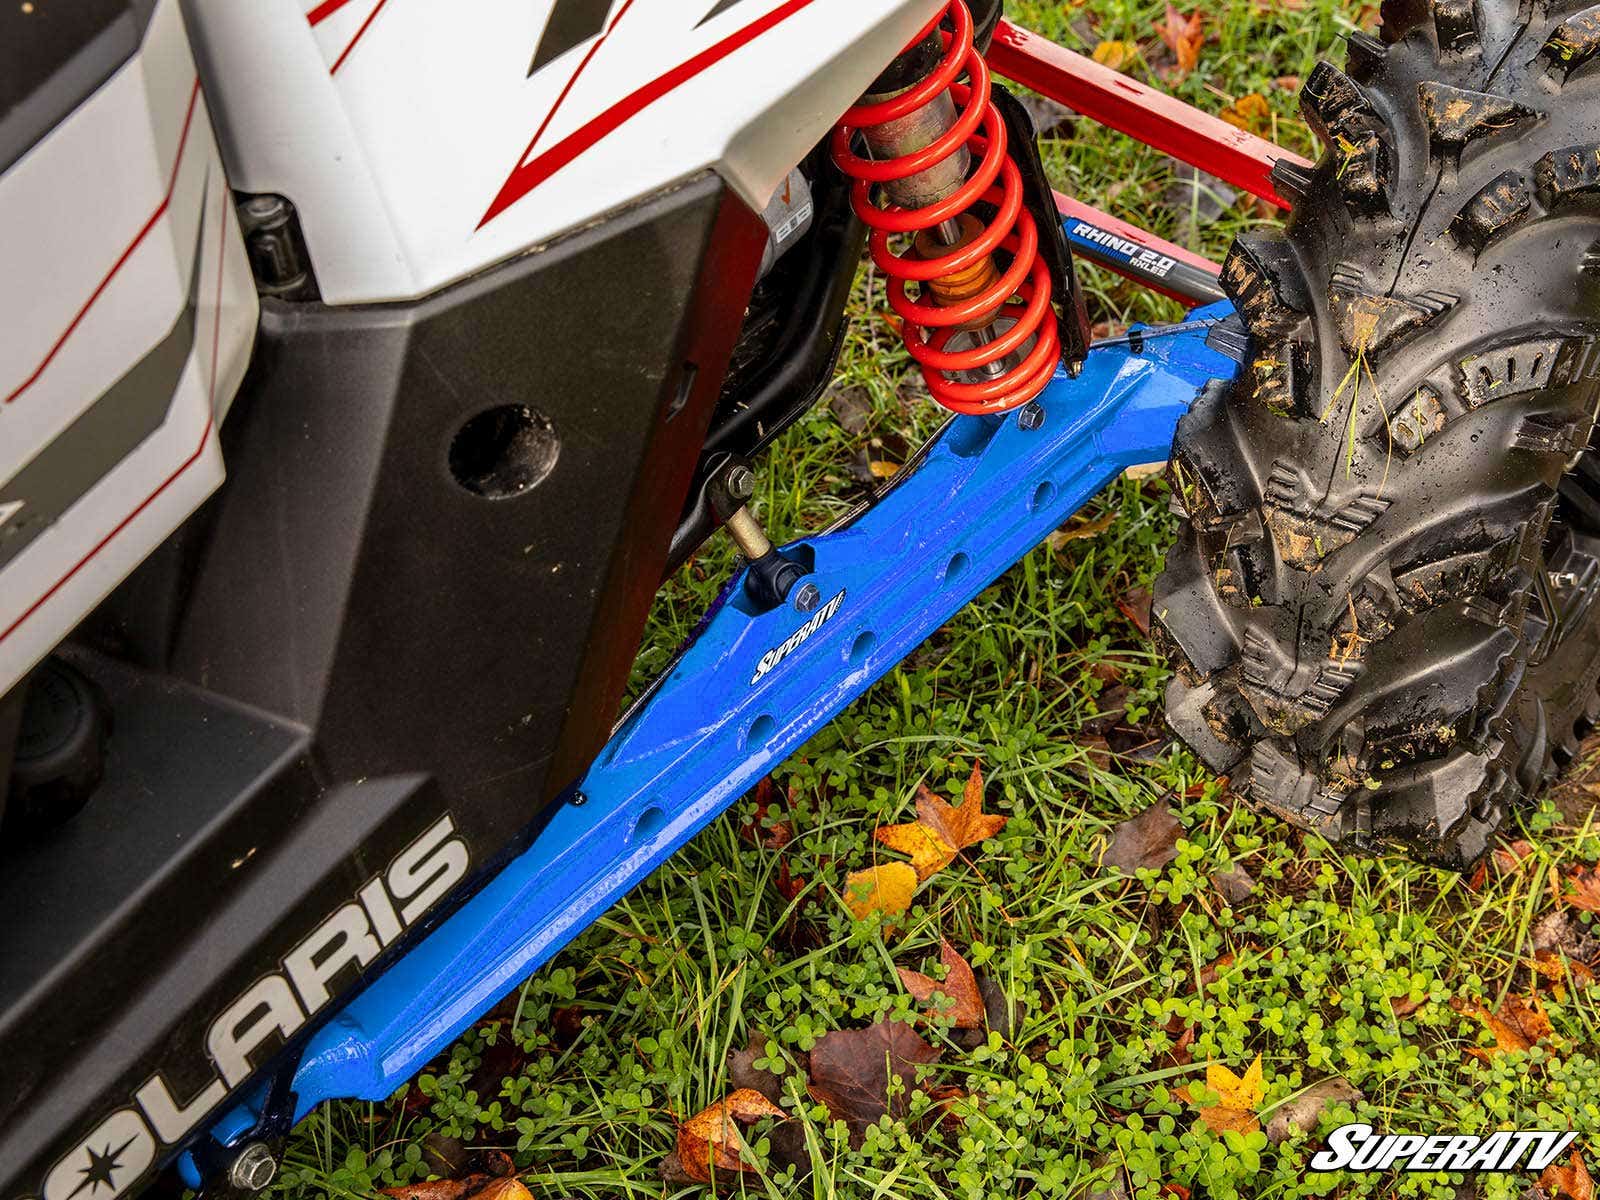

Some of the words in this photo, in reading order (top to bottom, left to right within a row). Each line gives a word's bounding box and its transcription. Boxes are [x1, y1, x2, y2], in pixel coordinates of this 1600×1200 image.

[1072, 222, 1140, 256] RHINO
[1139, 249, 1177, 271] 2.0
[1129, 257, 1168, 277] AXLES
[751, 589, 845, 685] SUPERATV
[16, 814, 470, 1200] OLARIS
